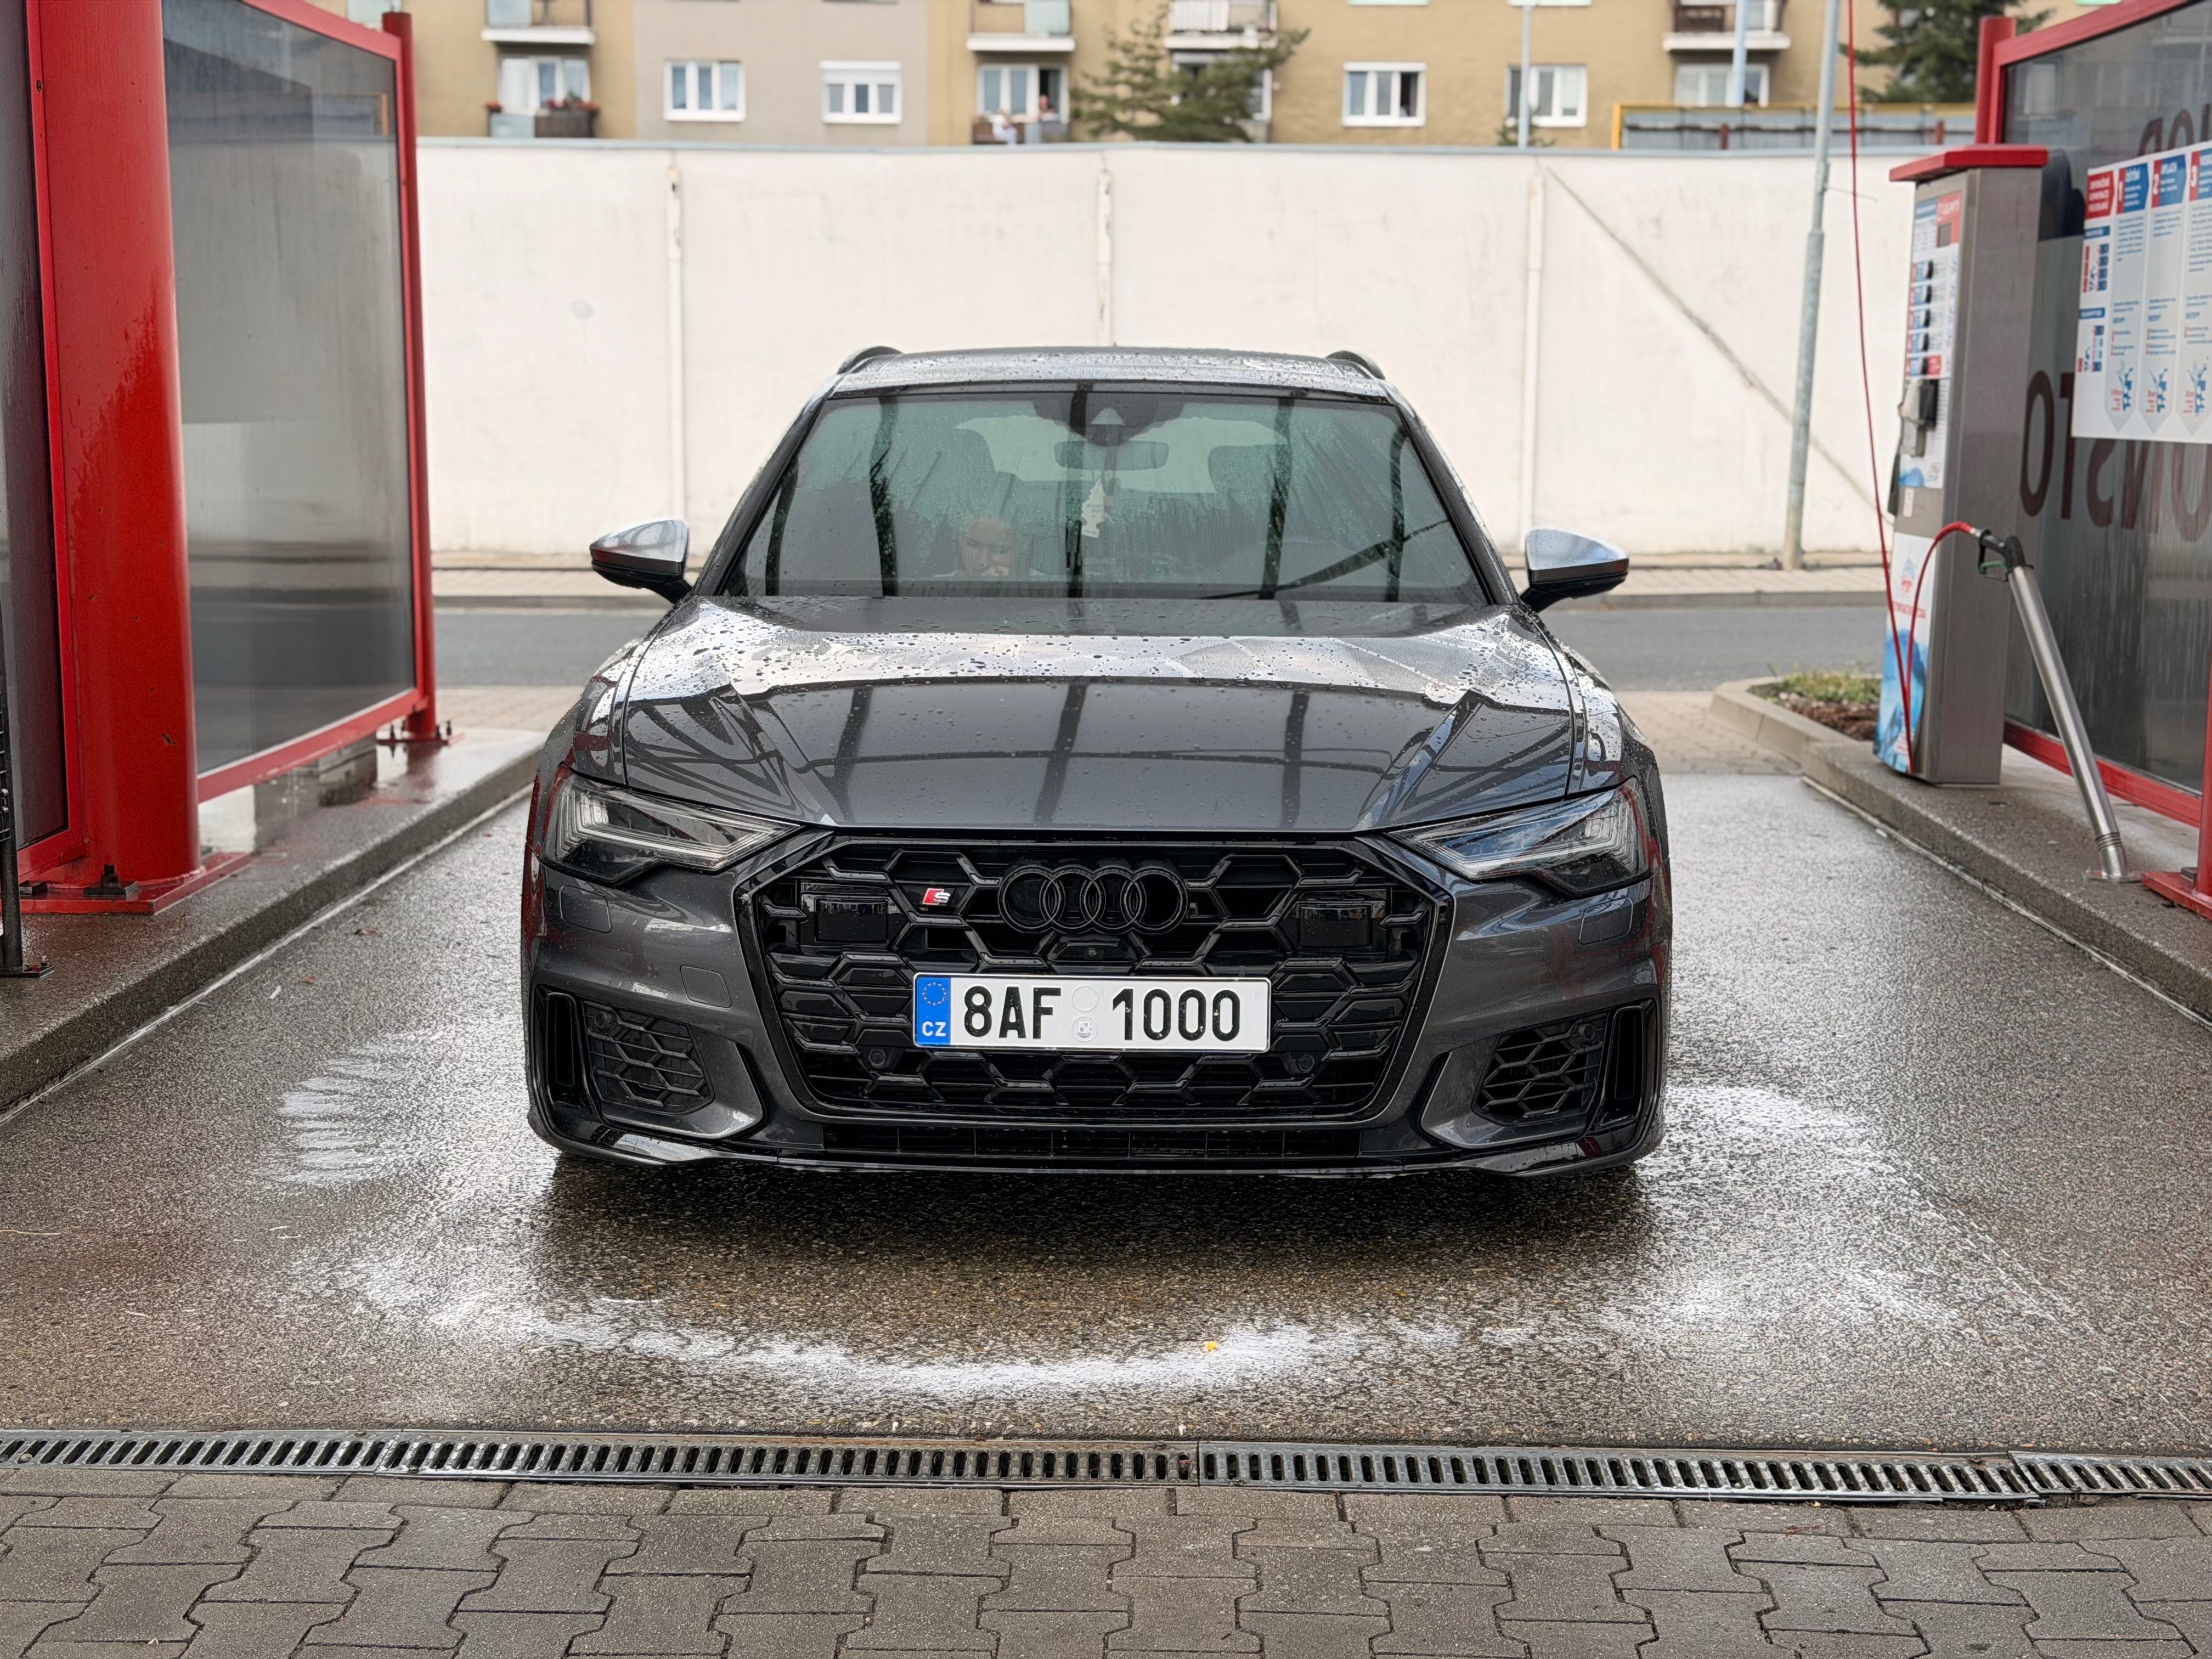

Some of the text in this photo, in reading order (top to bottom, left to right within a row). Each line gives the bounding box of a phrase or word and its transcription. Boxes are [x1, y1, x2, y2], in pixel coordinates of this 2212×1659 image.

[2153, 173, 2159, 195] 2
[2191, 165, 2197, 188] 3
[964, 985, 1240, 1041] 8AF 1000
[922, 1021, 946, 1036] CZ
